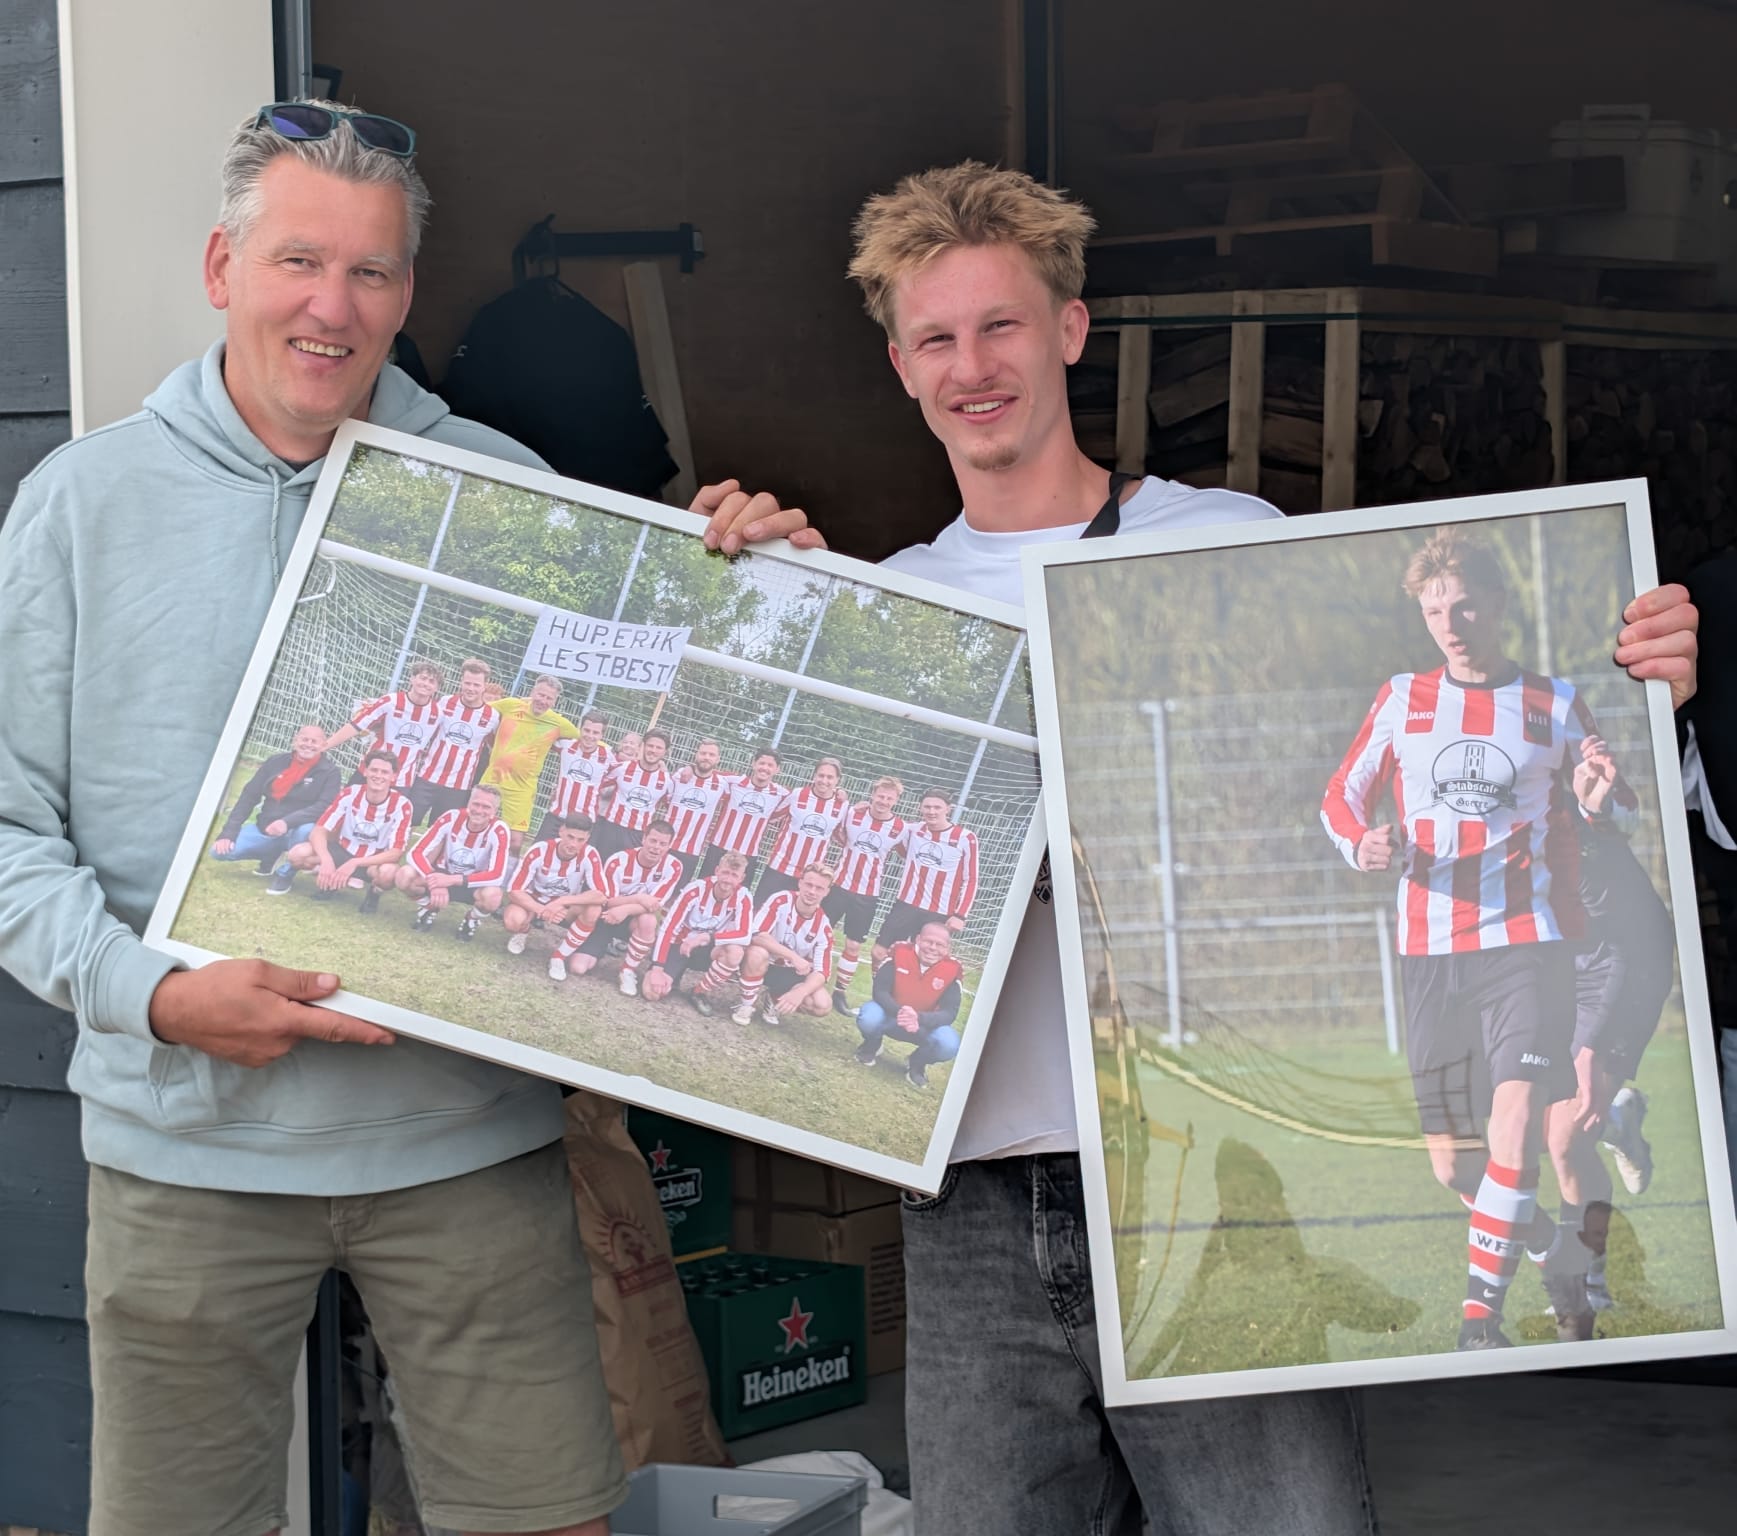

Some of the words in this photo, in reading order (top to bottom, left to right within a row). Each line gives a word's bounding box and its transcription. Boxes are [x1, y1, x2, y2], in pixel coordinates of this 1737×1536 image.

[1407, 711, 1435, 721] JAKO
[1520, 1053, 1550, 1067] JAKO
[660, 1180, 697, 1202] eken
[742, 1355, 850, 1406] Heineken
